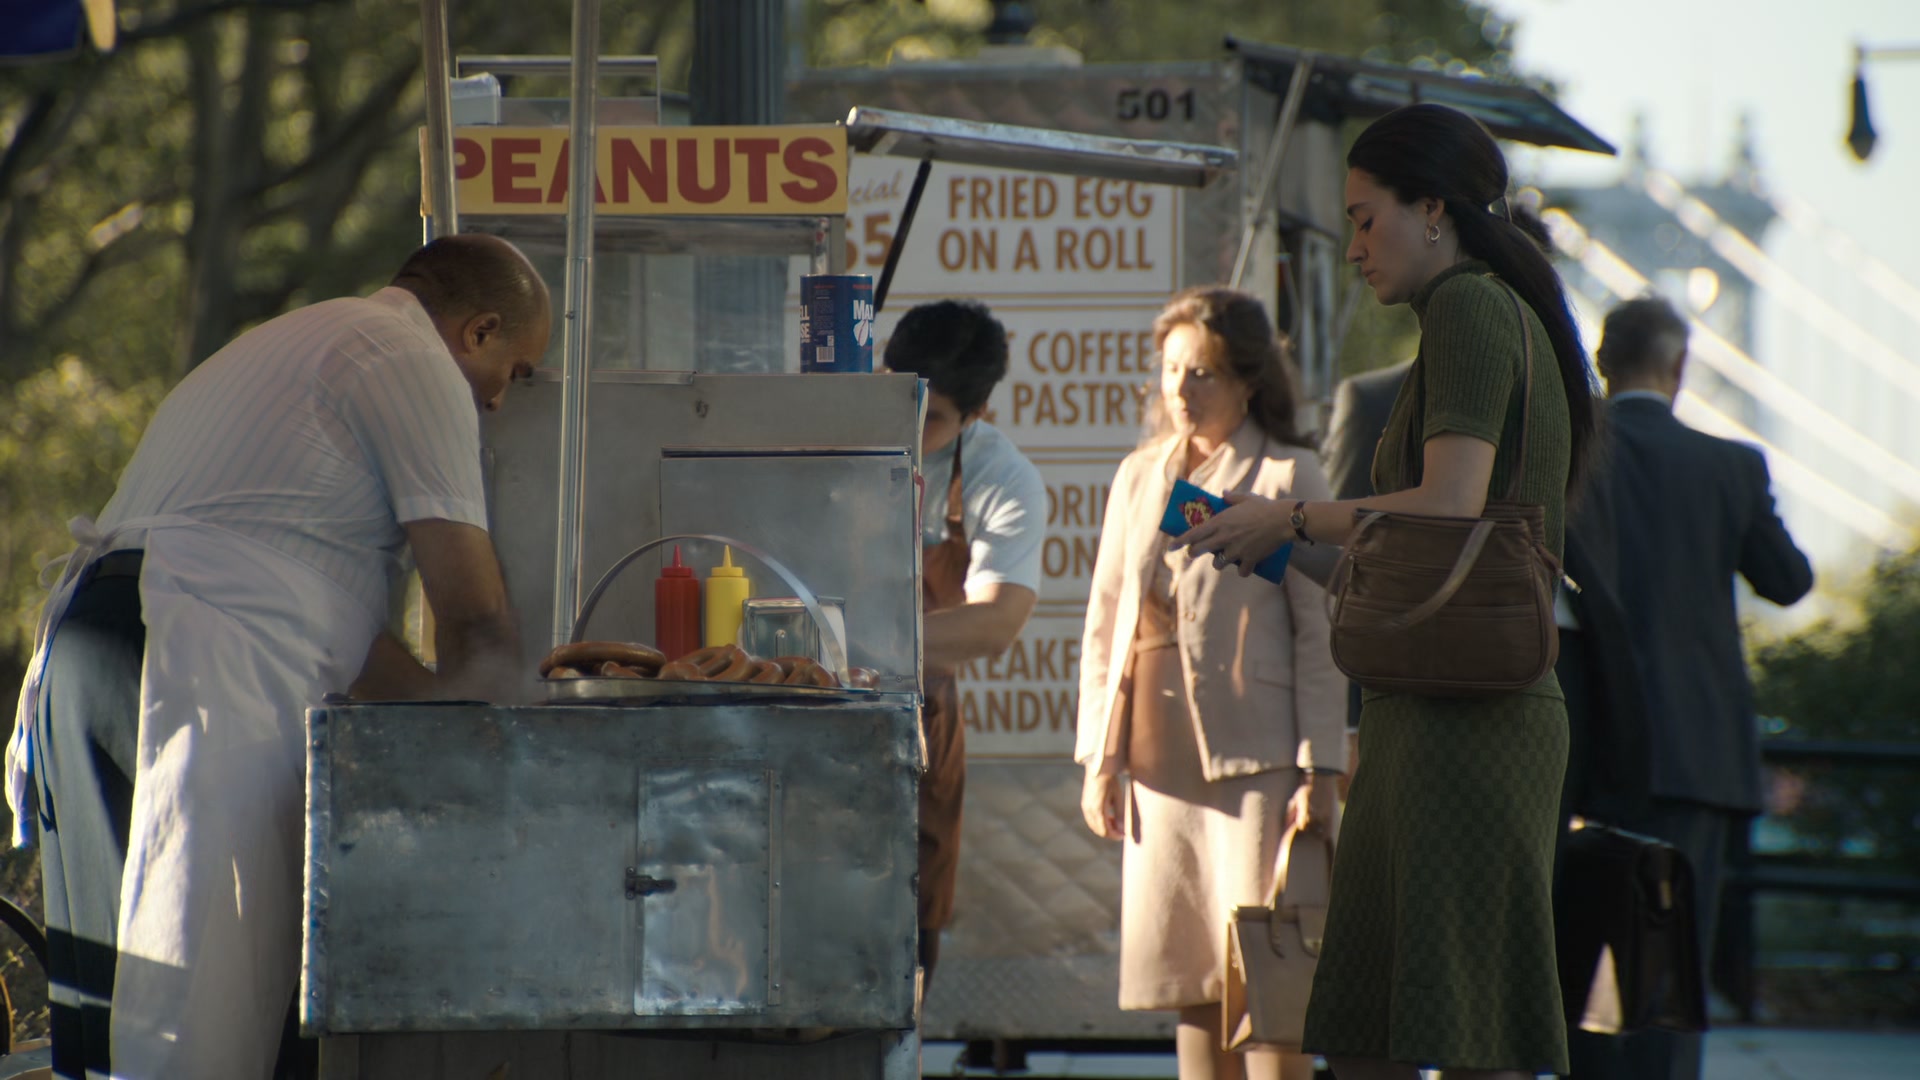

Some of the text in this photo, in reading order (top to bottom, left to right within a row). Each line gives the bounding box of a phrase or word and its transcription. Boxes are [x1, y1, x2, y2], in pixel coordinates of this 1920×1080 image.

[1118, 88, 1195, 121] 501
[949, 176, 1153, 219] FRIED EGG
[939, 227, 1153, 272] ON A ROLL
[1029, 331, 1153, 374] COFFEE
[1013, 382, 1148, 426] PASTRY
